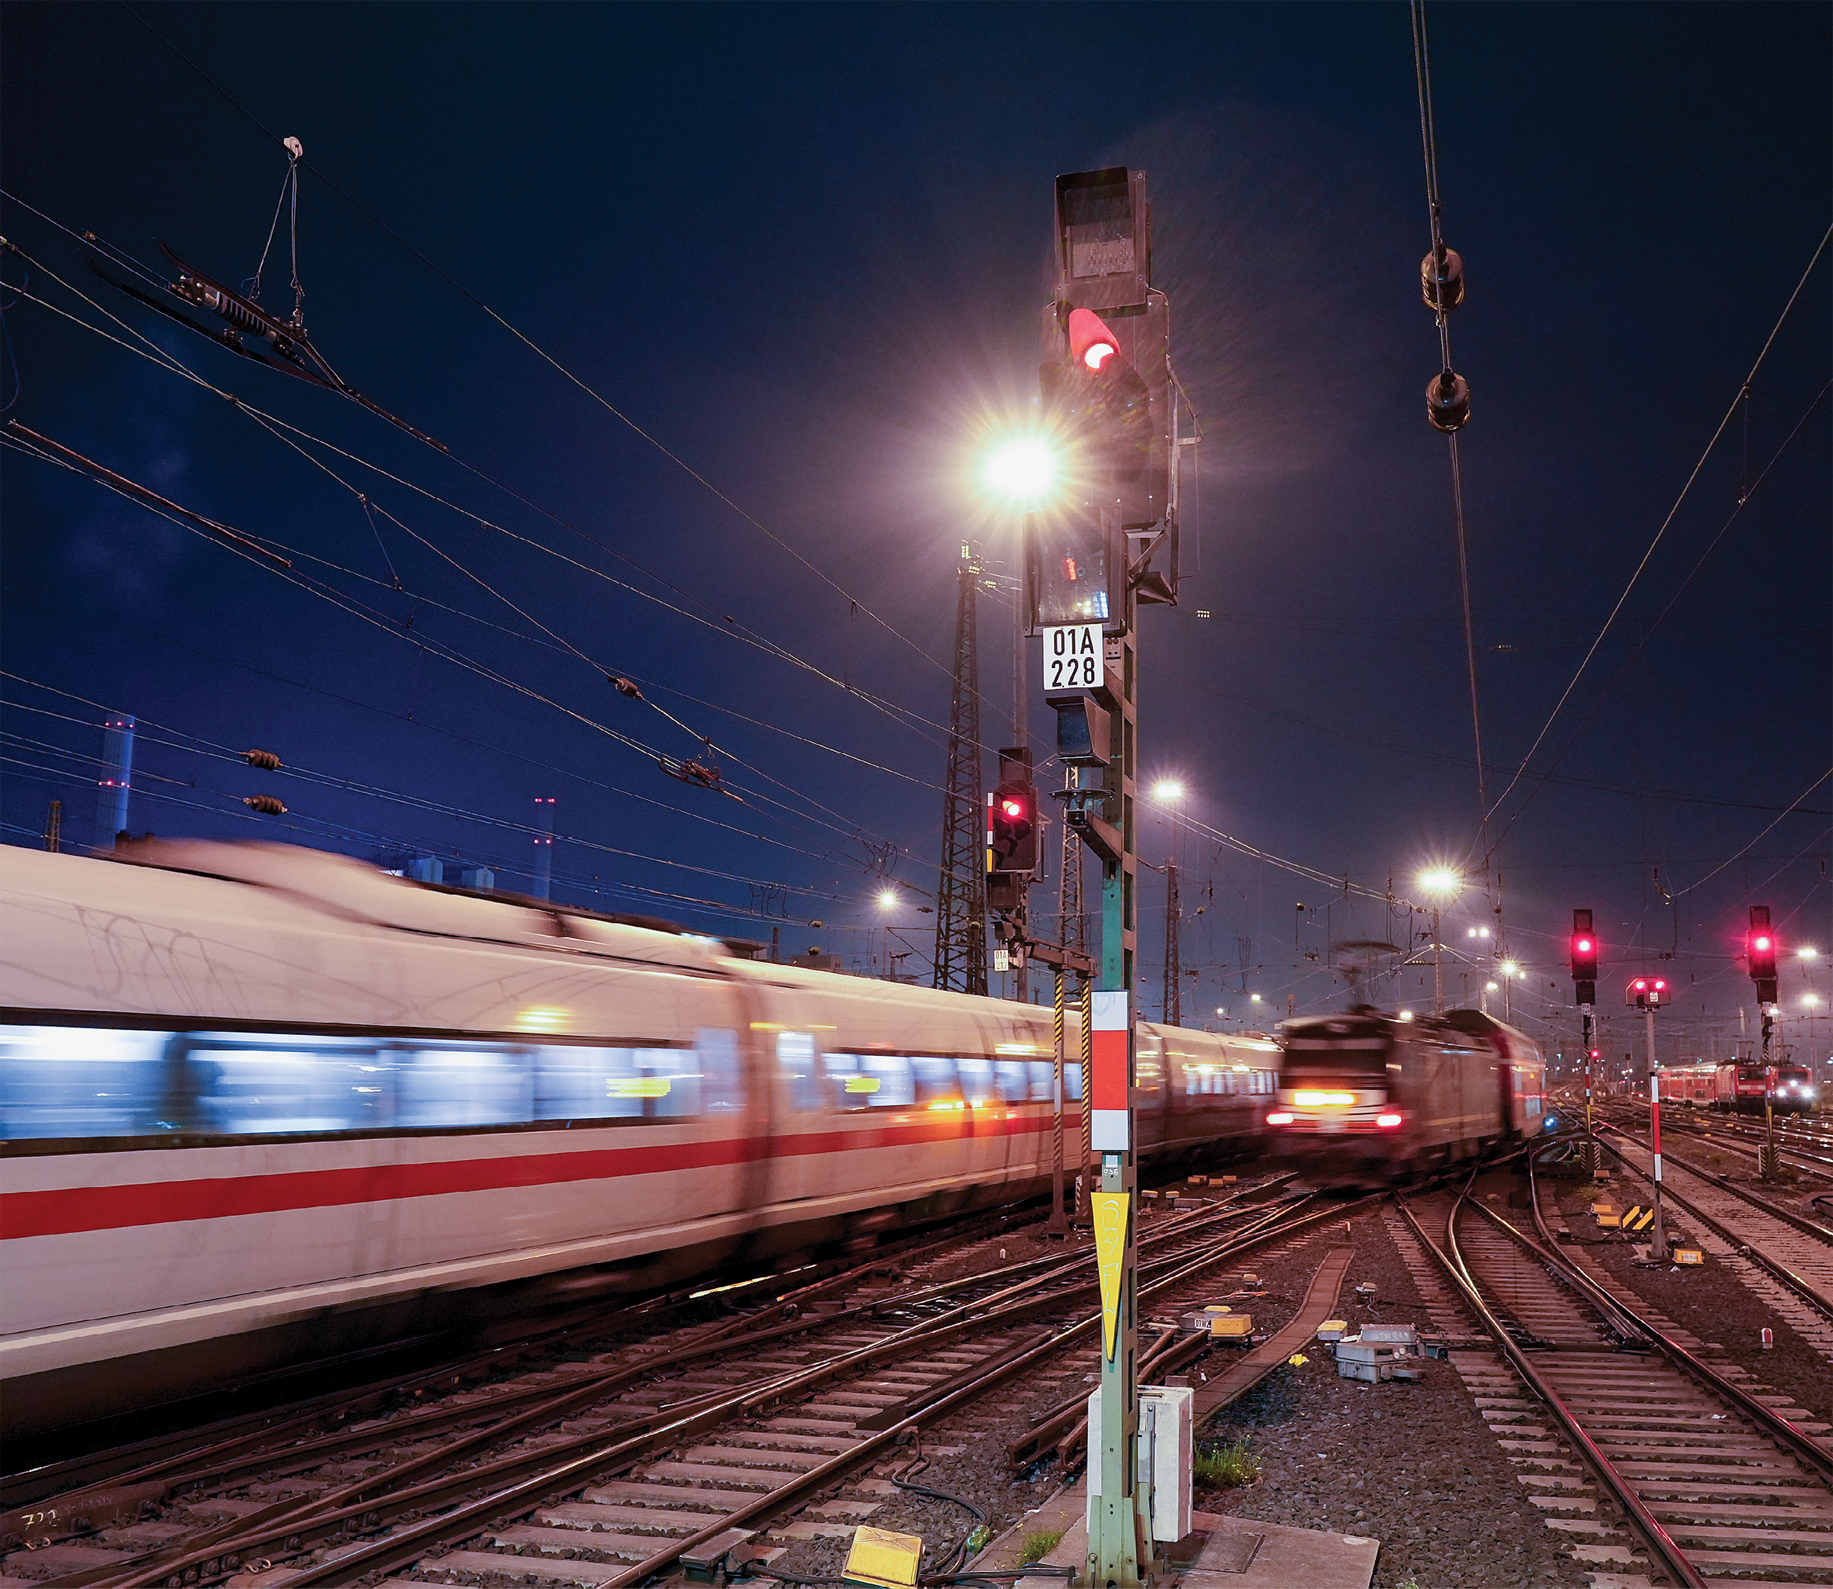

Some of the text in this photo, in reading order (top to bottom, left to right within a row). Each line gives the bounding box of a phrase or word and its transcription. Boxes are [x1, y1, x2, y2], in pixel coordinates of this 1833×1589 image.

[1053, 627, 1095, 656] 01A
[1051, 657, 1096, 688] 228
[995, 950, 1008, 960] 01A
